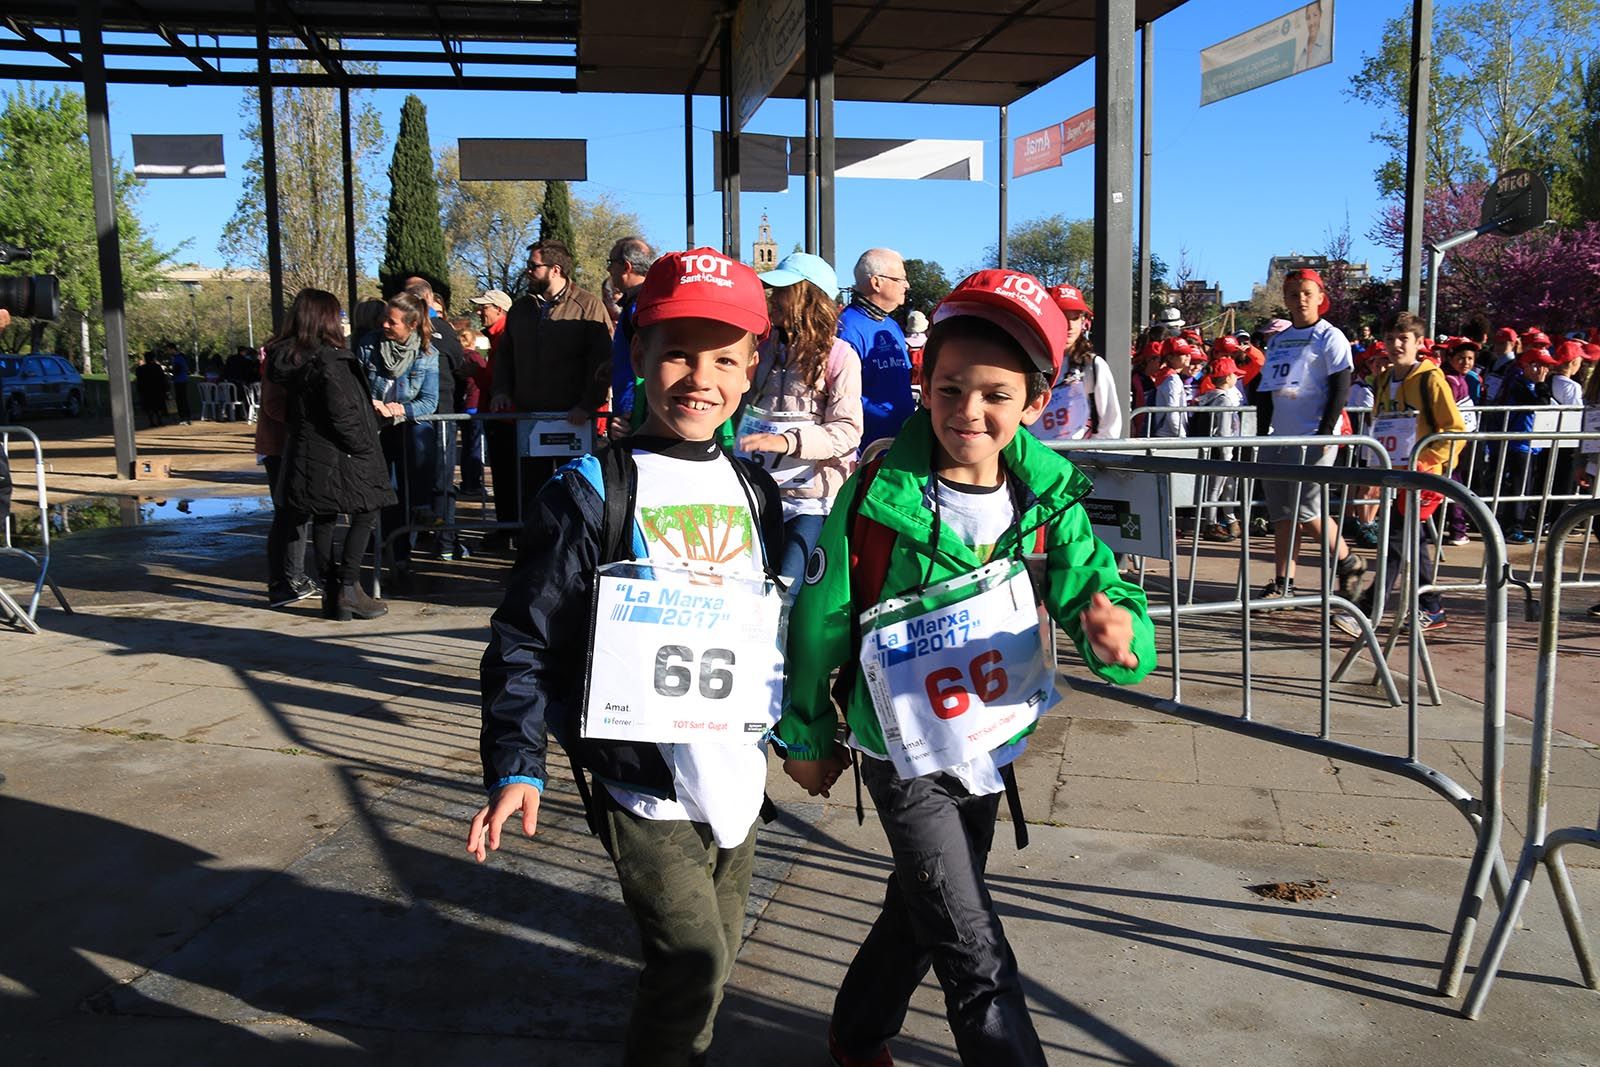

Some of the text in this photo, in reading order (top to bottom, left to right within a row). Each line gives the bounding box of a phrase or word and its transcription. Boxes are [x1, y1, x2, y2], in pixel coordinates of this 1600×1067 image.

[681, 254, 733, 277] TOT
[1003, 274, 1049, 304] TOT
[1272, 363, 1290, 379] 70
[1043, 407, 1069, 431] 69
[658, 587, 725, 611] Marxa
[906, 609, 970, 641] Marxa
[654, 645, 736, 700] 66
[925, 649, 1009, 721] 66
[612, 717, 632, 727] ferrer
[673, 720, 728, 731] TOT Sant Cugat
